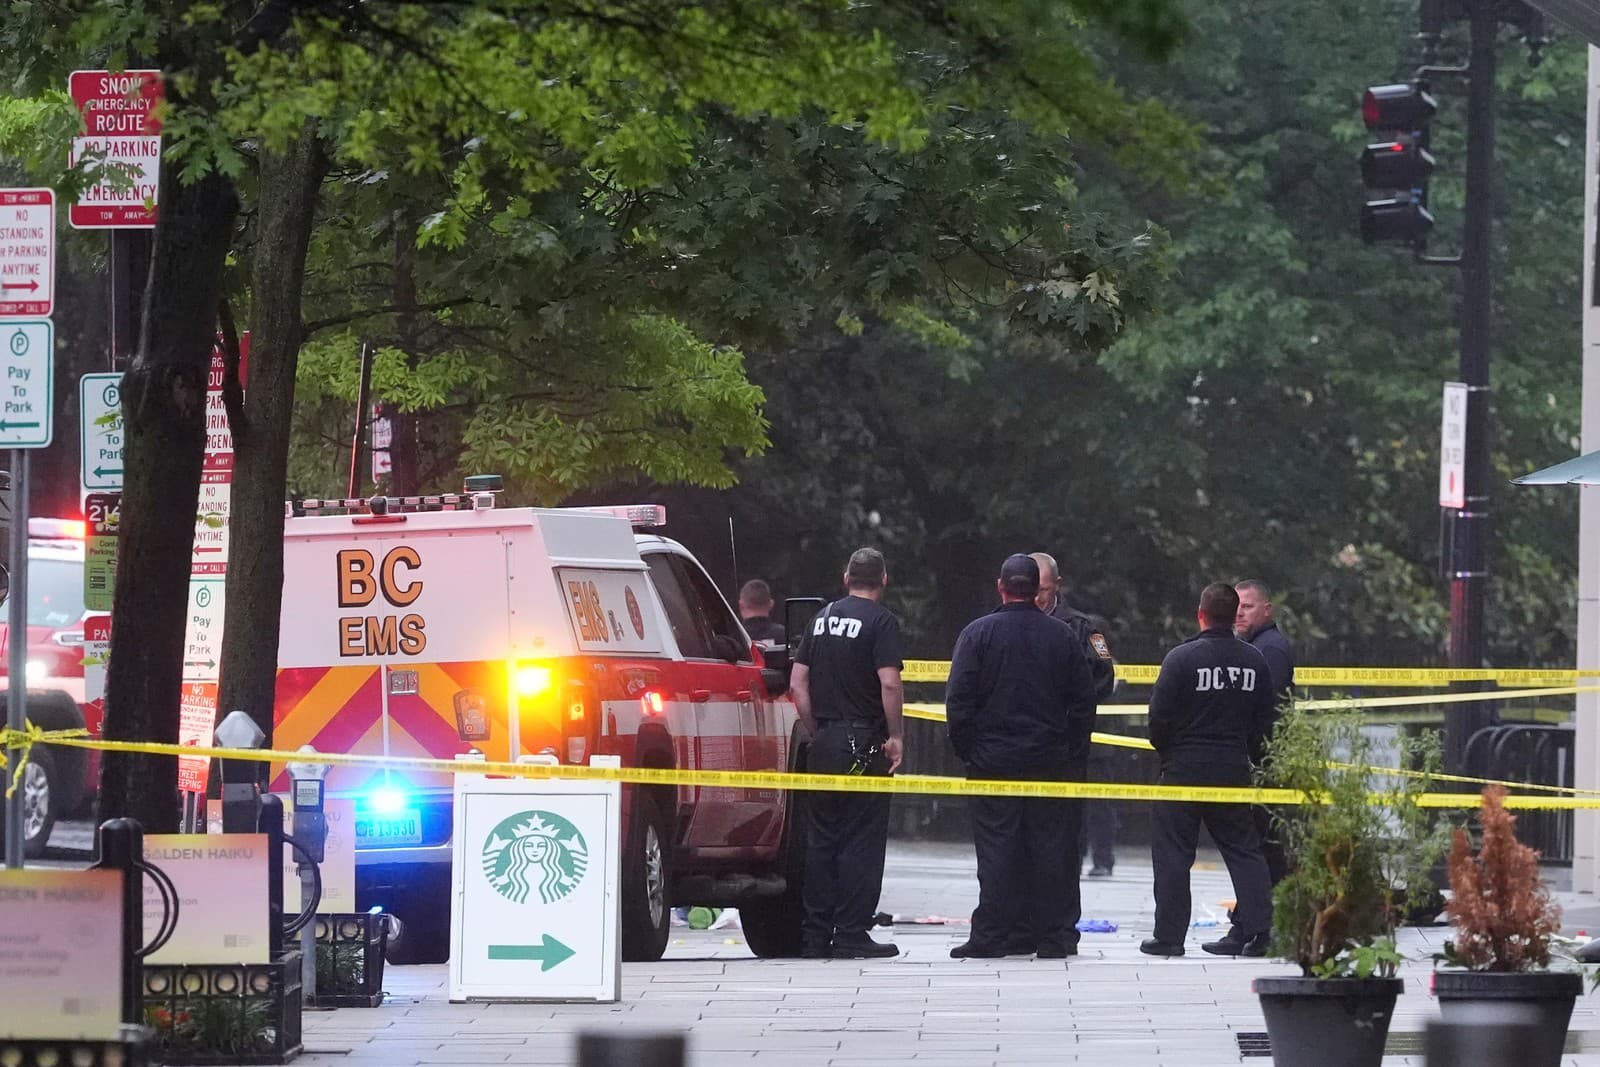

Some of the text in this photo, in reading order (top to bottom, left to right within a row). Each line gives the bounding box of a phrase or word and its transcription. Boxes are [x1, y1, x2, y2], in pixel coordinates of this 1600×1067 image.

[100, 77, 143, 95] SNOW
[96, 115, 145, 131] ROUTE
[105, 140, 158, 157] PARKING
[16, 209, 28, 222] NO
[100, 211, 113, 220] TOW
[0, 227, 44, 240] STANDING
[8, 245, 47, 257] PARKING
[2, 263, 41, 275] ANYTIME
[8, 366, 31, 381] Pay
[12, 385, 26, 397] To
[5, 401, 33, 413] Park
[106, 434, 120, 445] To
[206, 487, 216, 497] NO
[337, 545, 423, 608] BC
[567, 580, 609, 643] EMS
[813, 616, 862, 639] DCFD
[339, 613, 427, 656] EMS
[1195, 666, 1256, 691] DCFD
[207, 848, 254, 860] HAIKU
